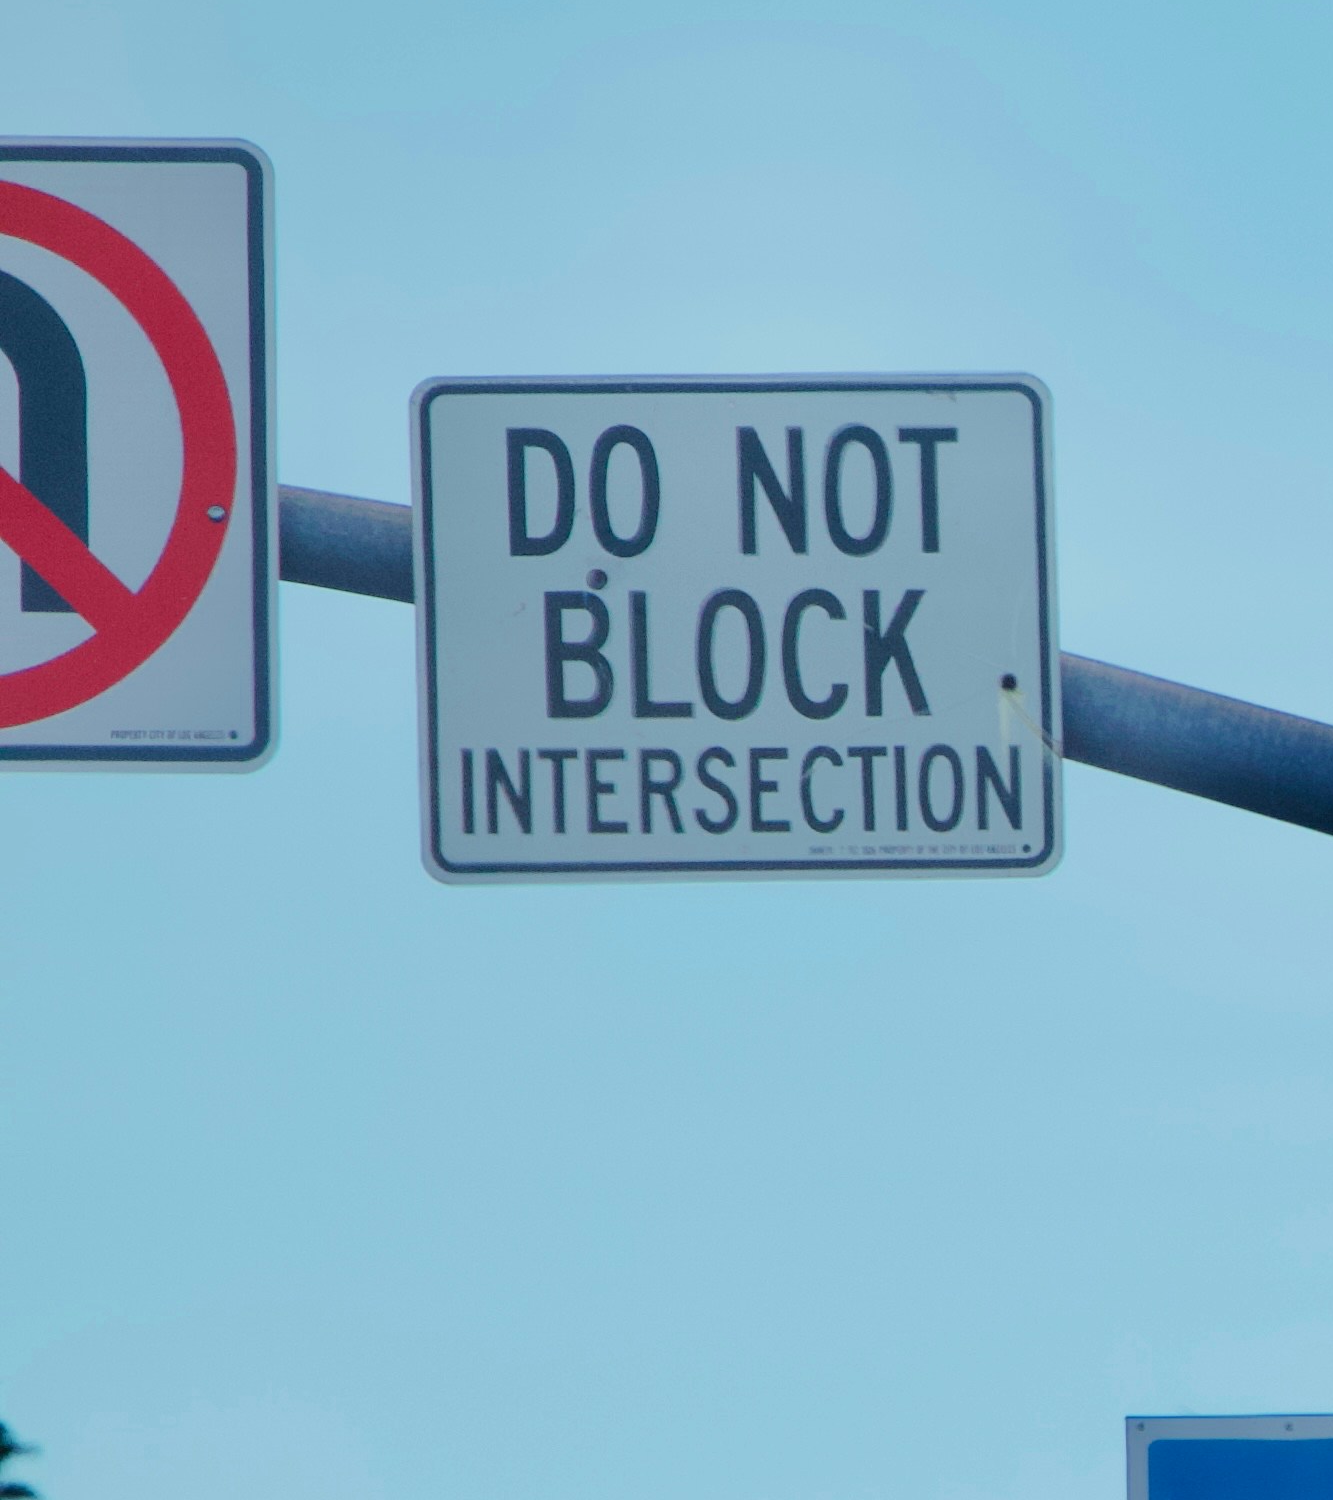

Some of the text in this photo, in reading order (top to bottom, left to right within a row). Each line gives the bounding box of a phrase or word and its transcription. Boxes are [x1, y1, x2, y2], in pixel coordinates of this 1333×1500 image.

[505, 424, 958, 558] DO NOT
[544, 589, 931, 721] BLOCK
[461, 744, 1023, 836] INTERSECTION
